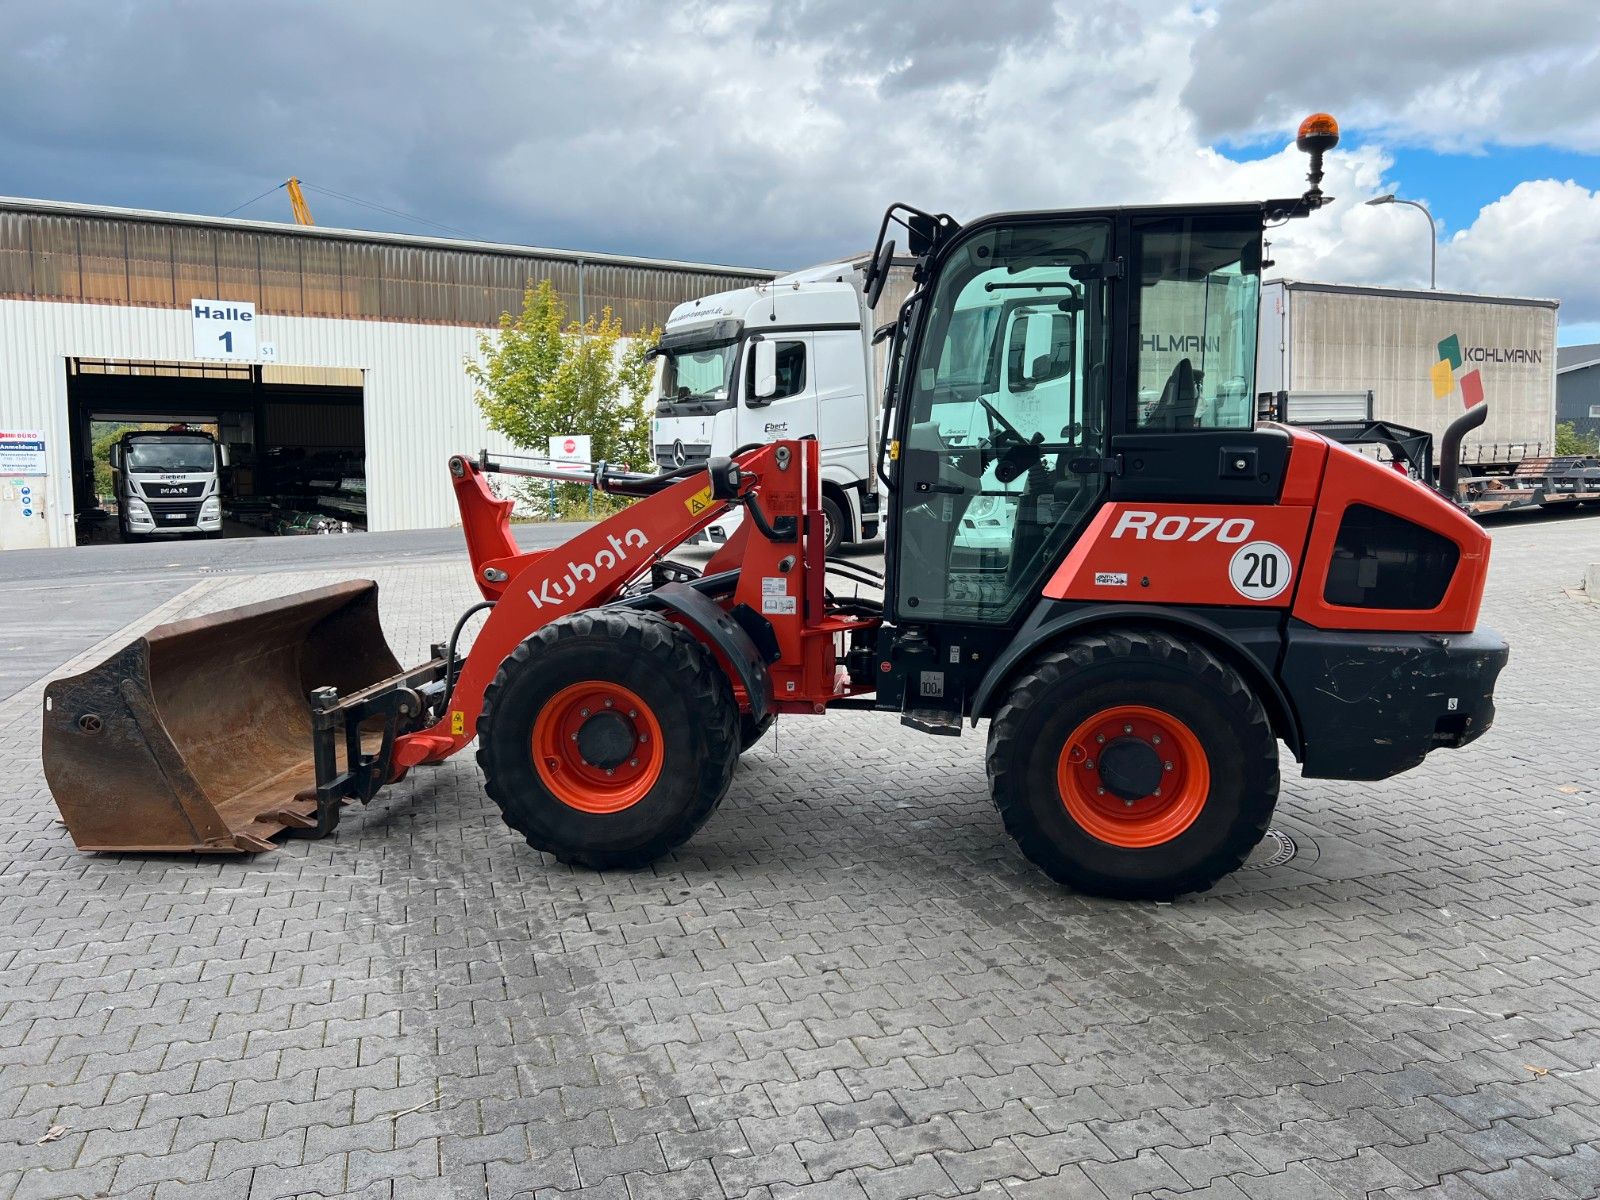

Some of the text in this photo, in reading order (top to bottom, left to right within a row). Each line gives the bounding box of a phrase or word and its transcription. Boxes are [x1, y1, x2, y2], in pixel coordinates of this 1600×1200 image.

[194, 305, 252, 322] Halle
[218, 330, 233, 353] 1
[1139, 334, 1220, 353] HLMANN
[262, 347, 274, 355] S1
[1464, 347, 1542, 363] KOHLMANN
[764, 421, 789, 433] Ebert
[527, 528, 650, 609] Kubota
[1242, 552, 1278, 589] 20
[921, 681, 937, 695] 100
